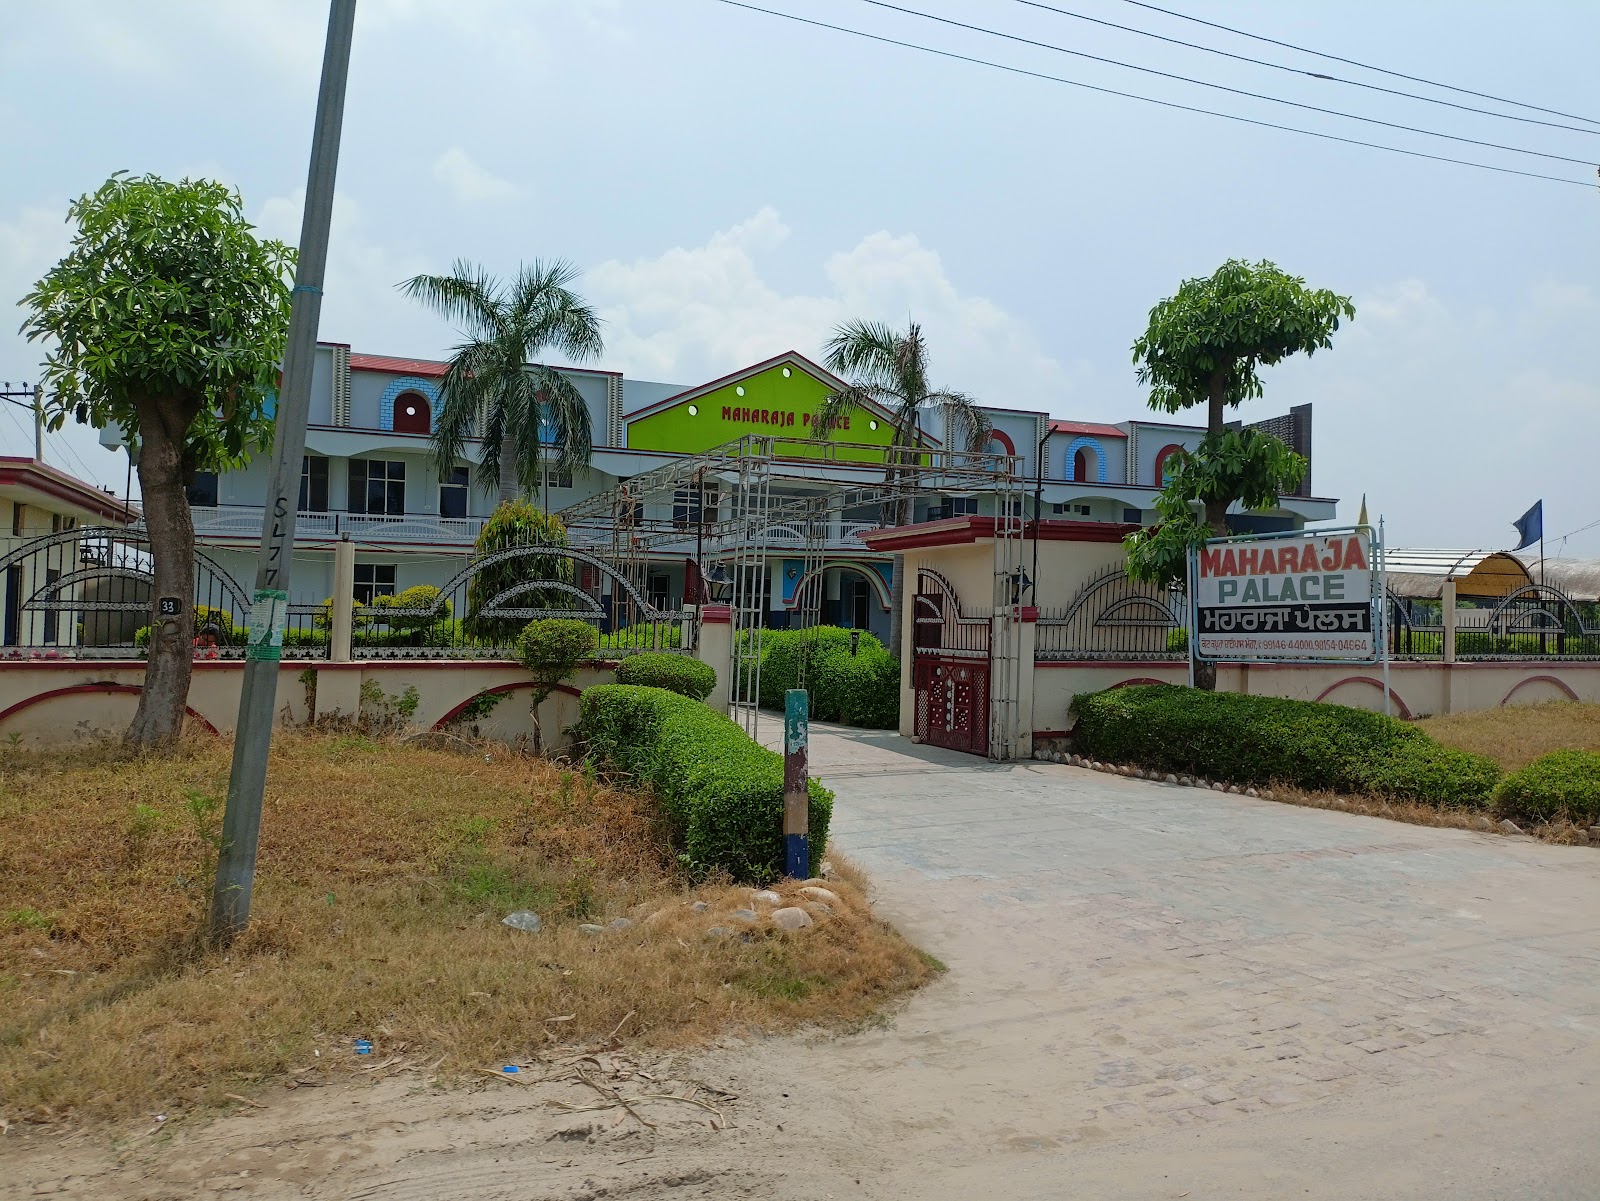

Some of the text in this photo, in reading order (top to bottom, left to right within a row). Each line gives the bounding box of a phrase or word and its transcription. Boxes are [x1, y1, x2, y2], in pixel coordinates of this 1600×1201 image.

[722, 406, 795, 427] MAHARAJA
[1201, 537, 1368, 578] MAHARAJA
[1218, 574, 1345, 603] PALACE
[1204, 607, 1291, 631] ਮਹਾਰਾਜਾ
